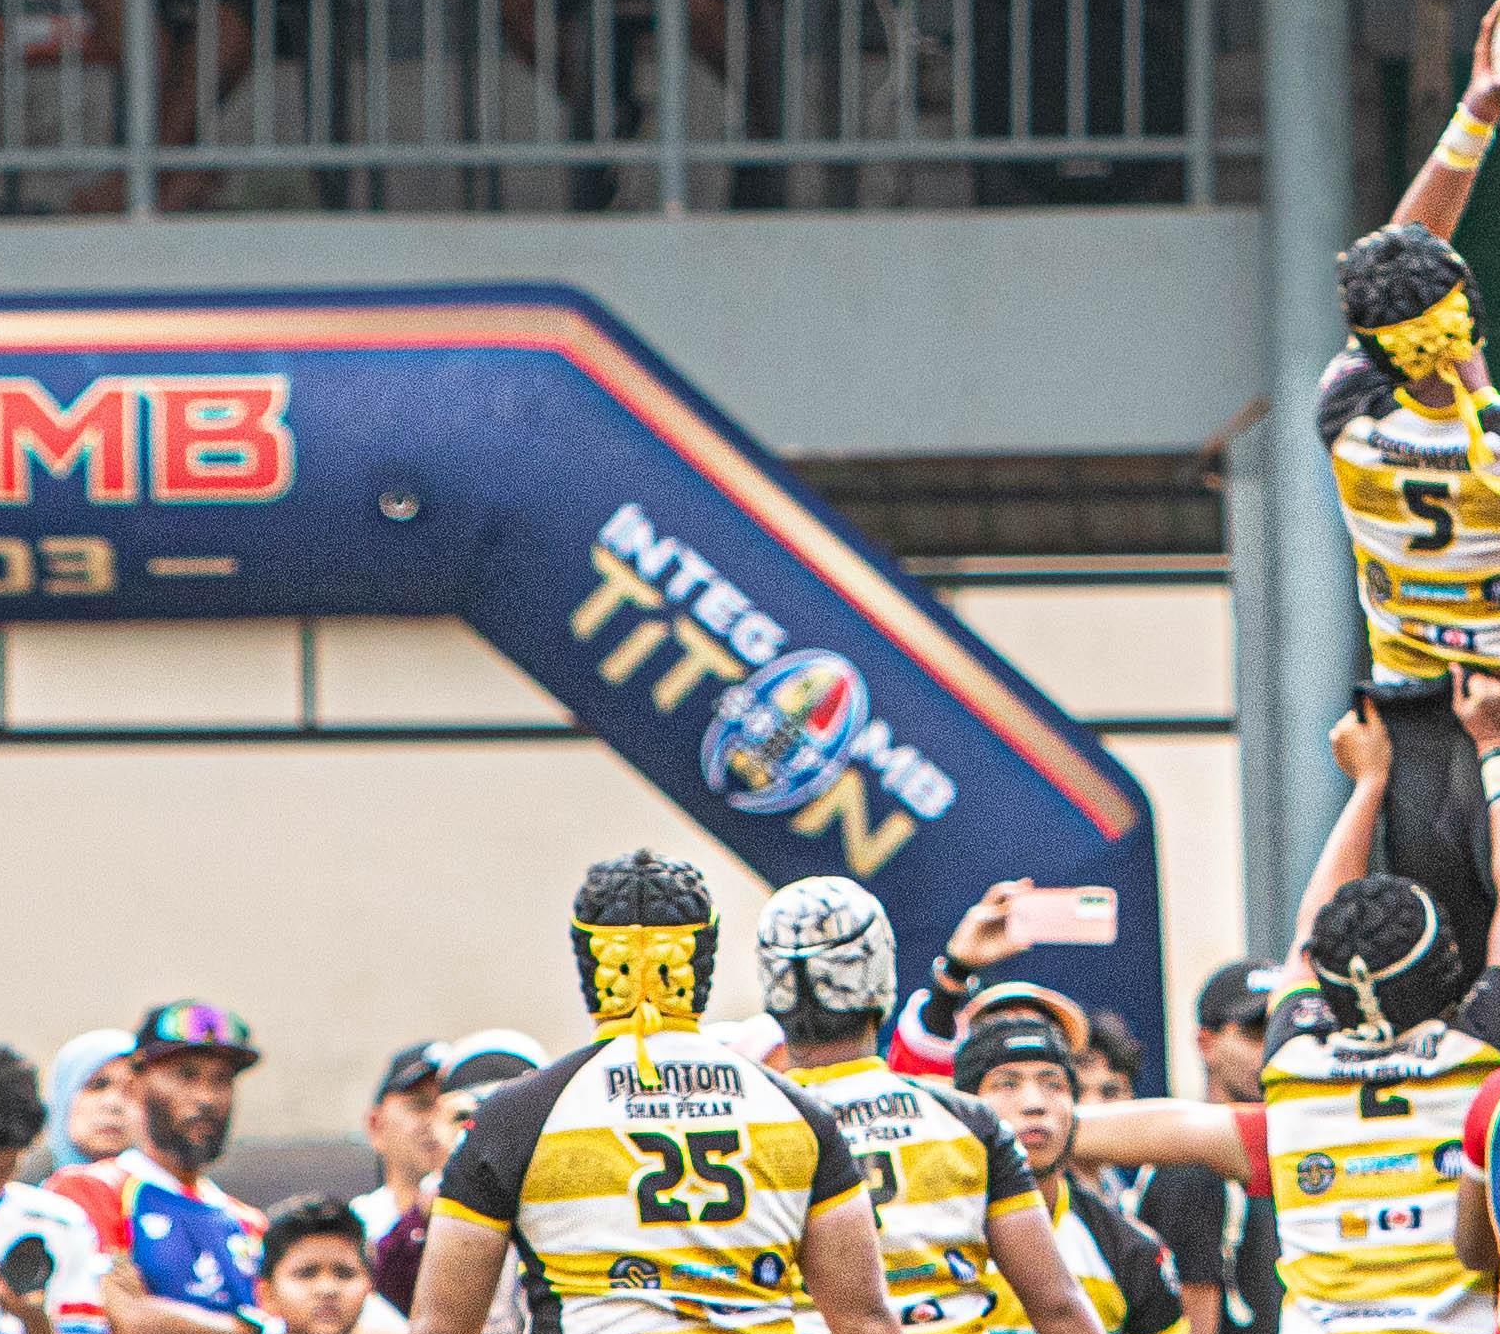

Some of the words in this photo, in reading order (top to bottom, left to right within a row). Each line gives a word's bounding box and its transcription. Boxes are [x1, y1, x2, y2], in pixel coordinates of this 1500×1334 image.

[1402, 478, 1454, 551] 5
[604, 1061, 746, 1102] PHNTOM
[626, 1128, 747, 1225] 25
